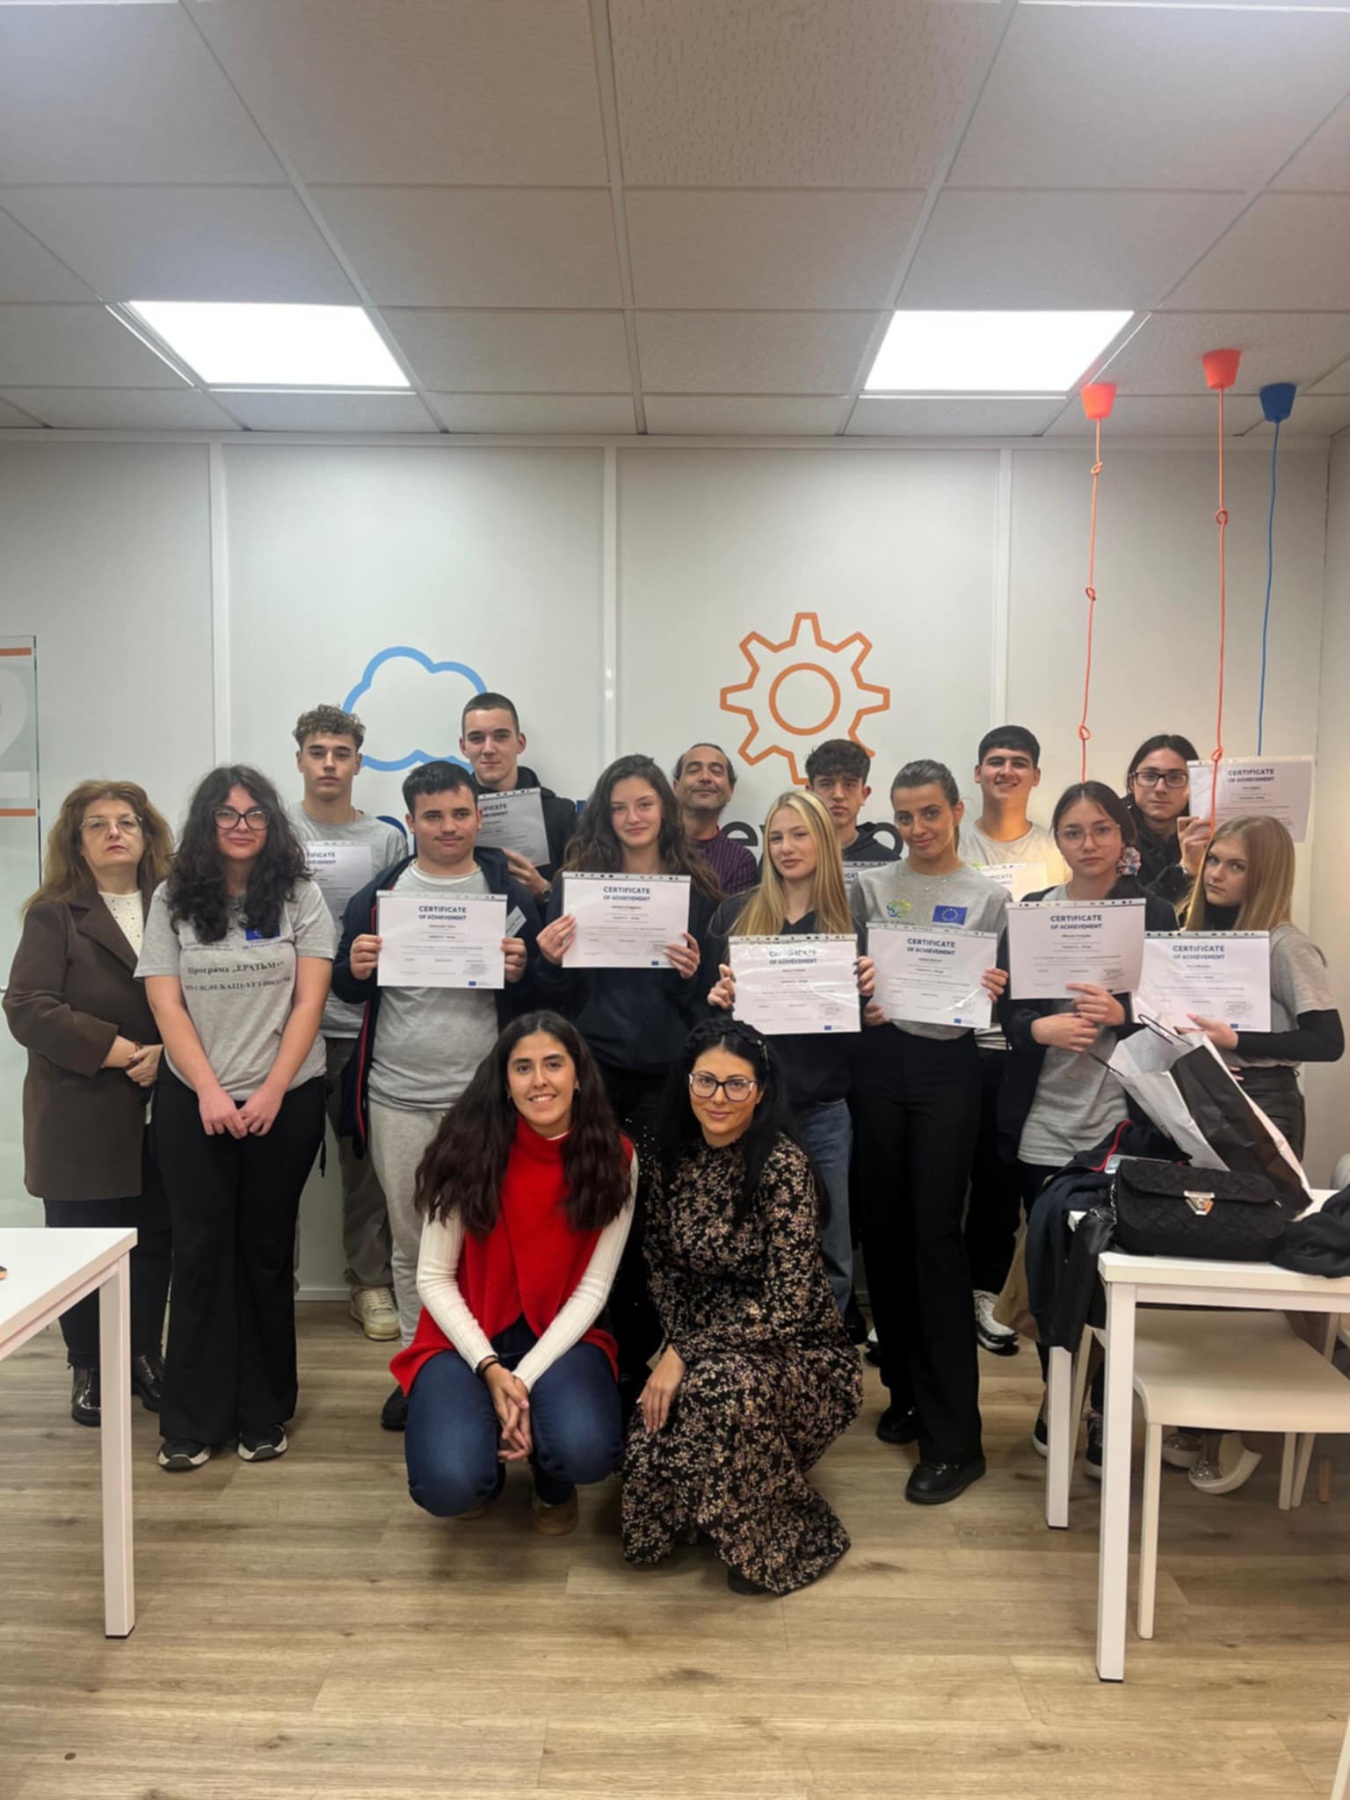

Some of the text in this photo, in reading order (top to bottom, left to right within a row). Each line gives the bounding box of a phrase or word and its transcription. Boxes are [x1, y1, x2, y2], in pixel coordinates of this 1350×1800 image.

[603, 886, 651, 894] CERTIFICATE
[418, 905, 467, 913] CERTIFICATE
[1050, 914, 1102, 922] CERTIFICATE
[907, 937, 956, 948] CERTIFICATE
